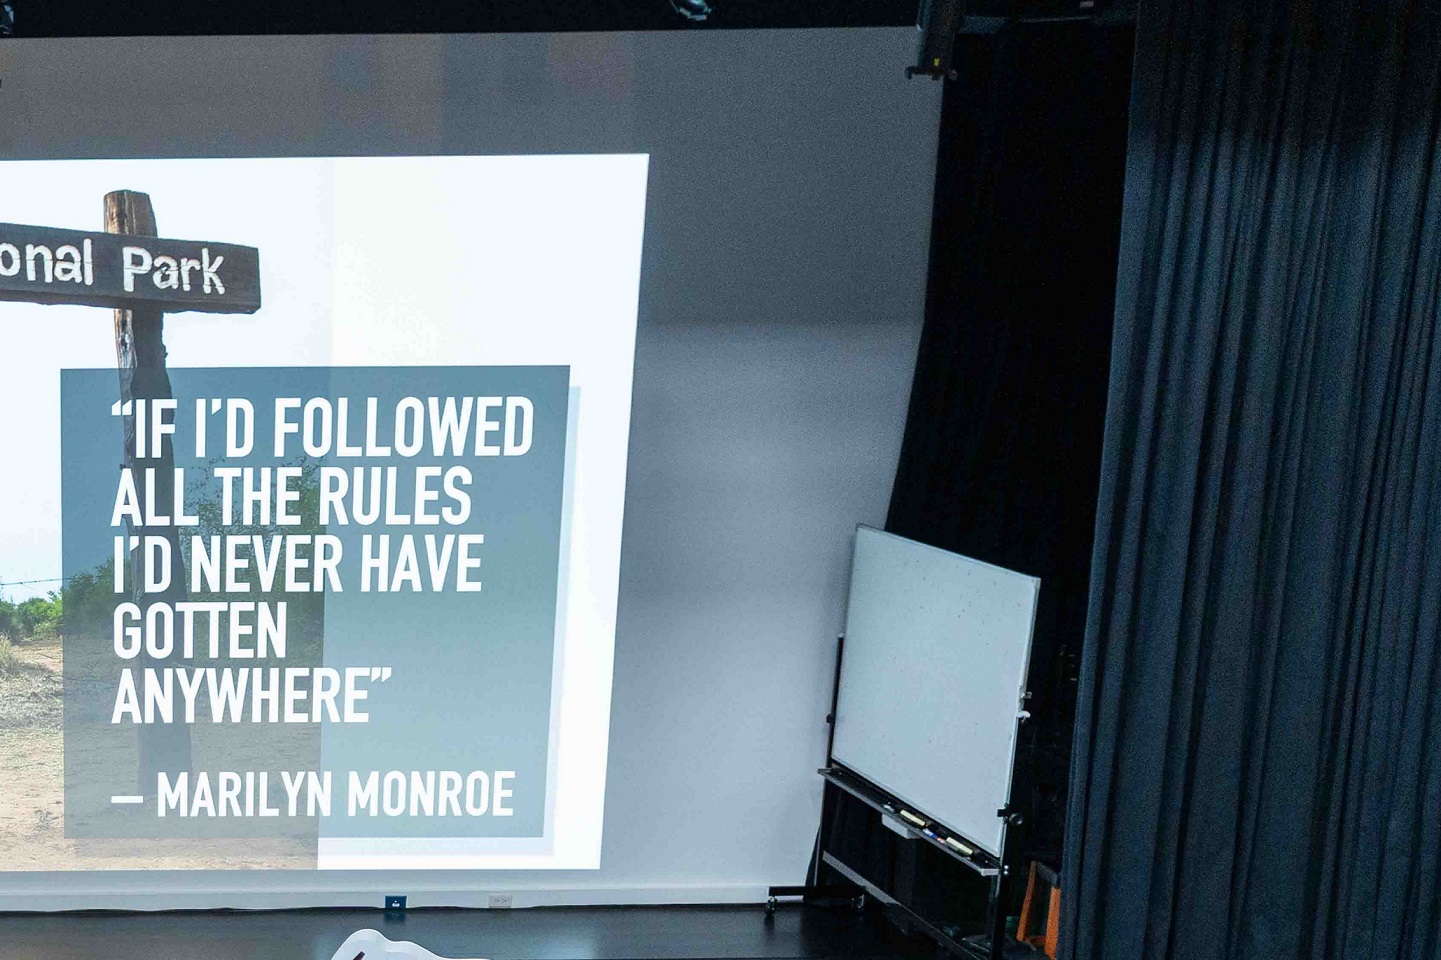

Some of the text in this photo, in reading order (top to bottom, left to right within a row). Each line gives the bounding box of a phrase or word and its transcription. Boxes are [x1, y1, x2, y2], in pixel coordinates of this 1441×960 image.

[123, 245, 228, 295] Park
[195, 398, 255, 458] I’D
[274, 396, 534, 458] FOLLOWED
[110, 465, 474, 527] ALL THE RULES
[113, 534, 485, 594] I’D NEVER HAVE
[113, 601, 288, 660] GOTTEN
[157, 770, 333, 819] MARILYN
[347, 770, 517, 818] MONROE
